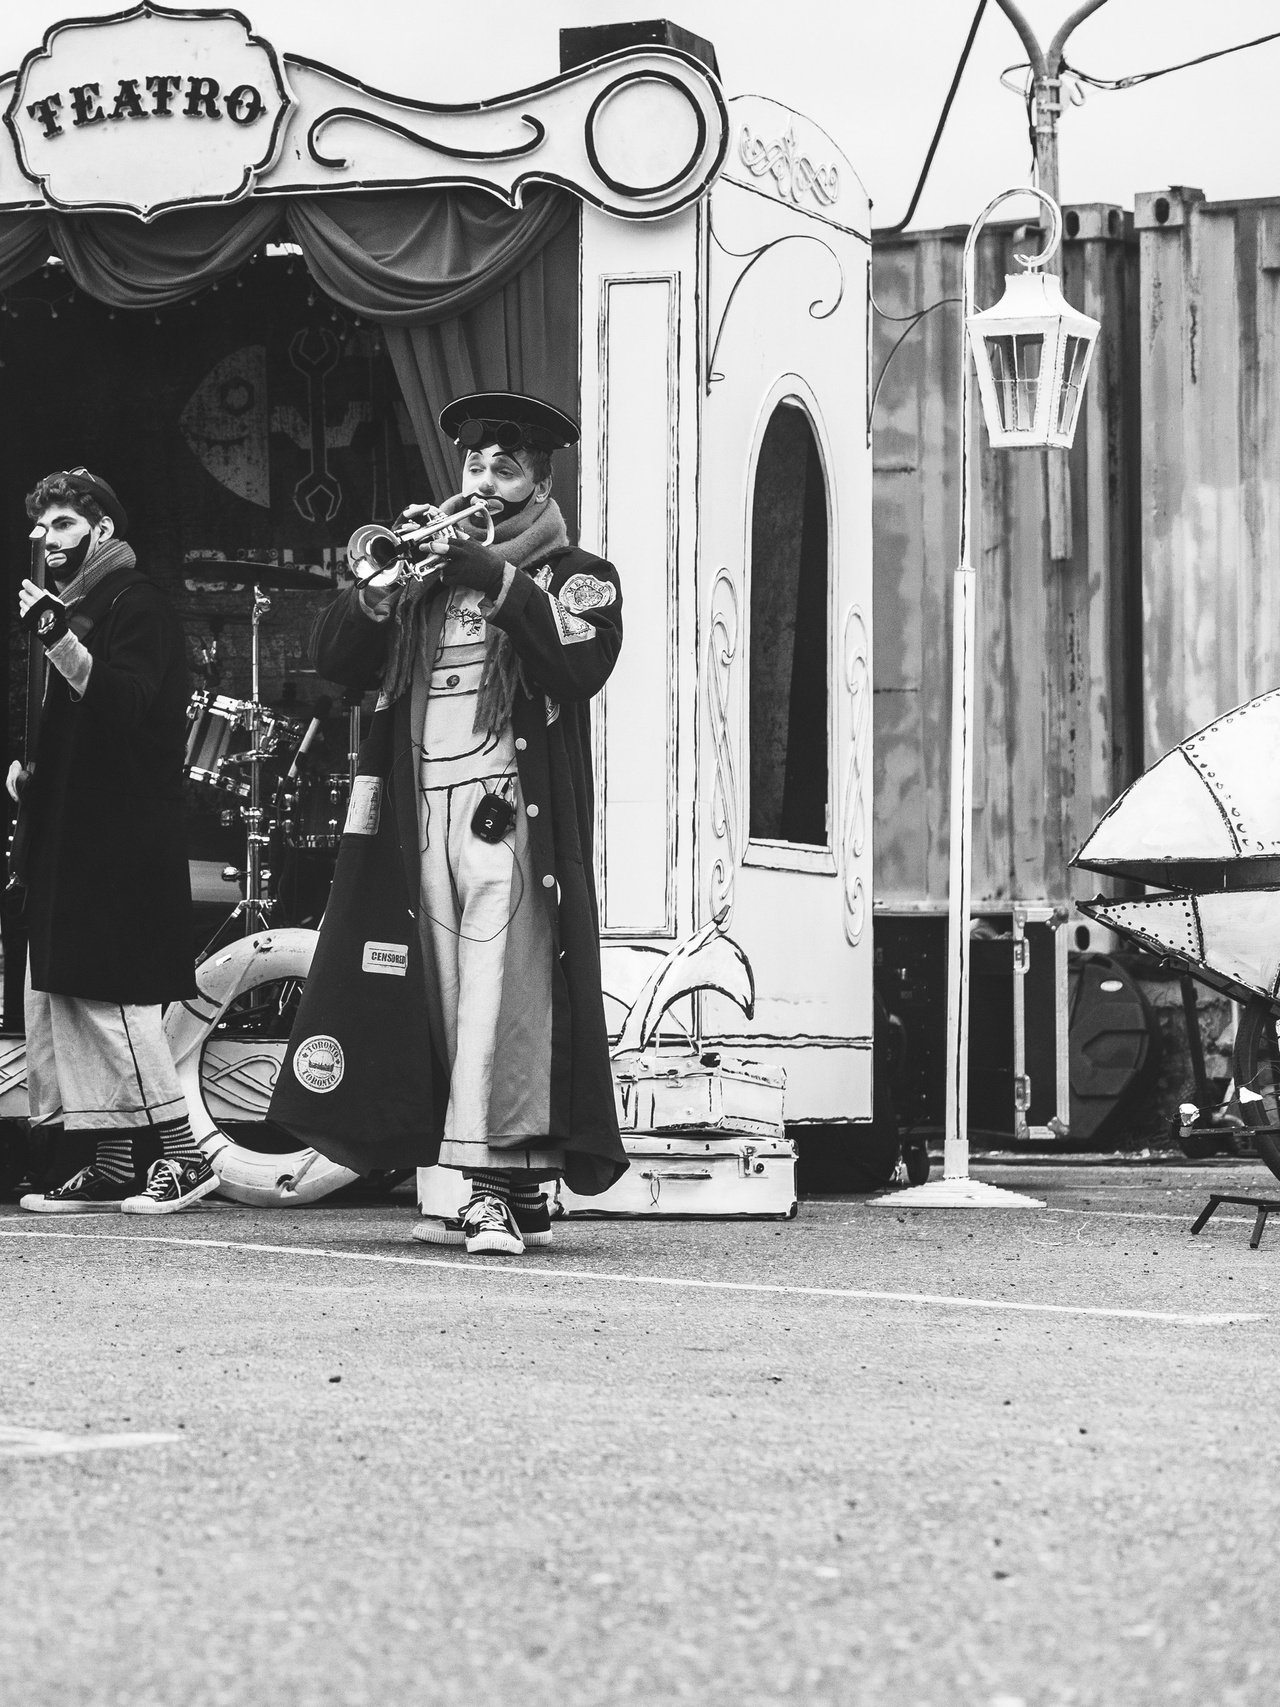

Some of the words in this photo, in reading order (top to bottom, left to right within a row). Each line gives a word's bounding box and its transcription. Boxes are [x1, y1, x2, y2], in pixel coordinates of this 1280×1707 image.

[26, 76, 267, 138] TEATRO
[566, 579, 605, 595] MEXICO
[371, 951, 406, 965] CENSORED
[306, 1041, 339, 1058] TORONTO
[302, 1069, 336, 1087] TORONTO
